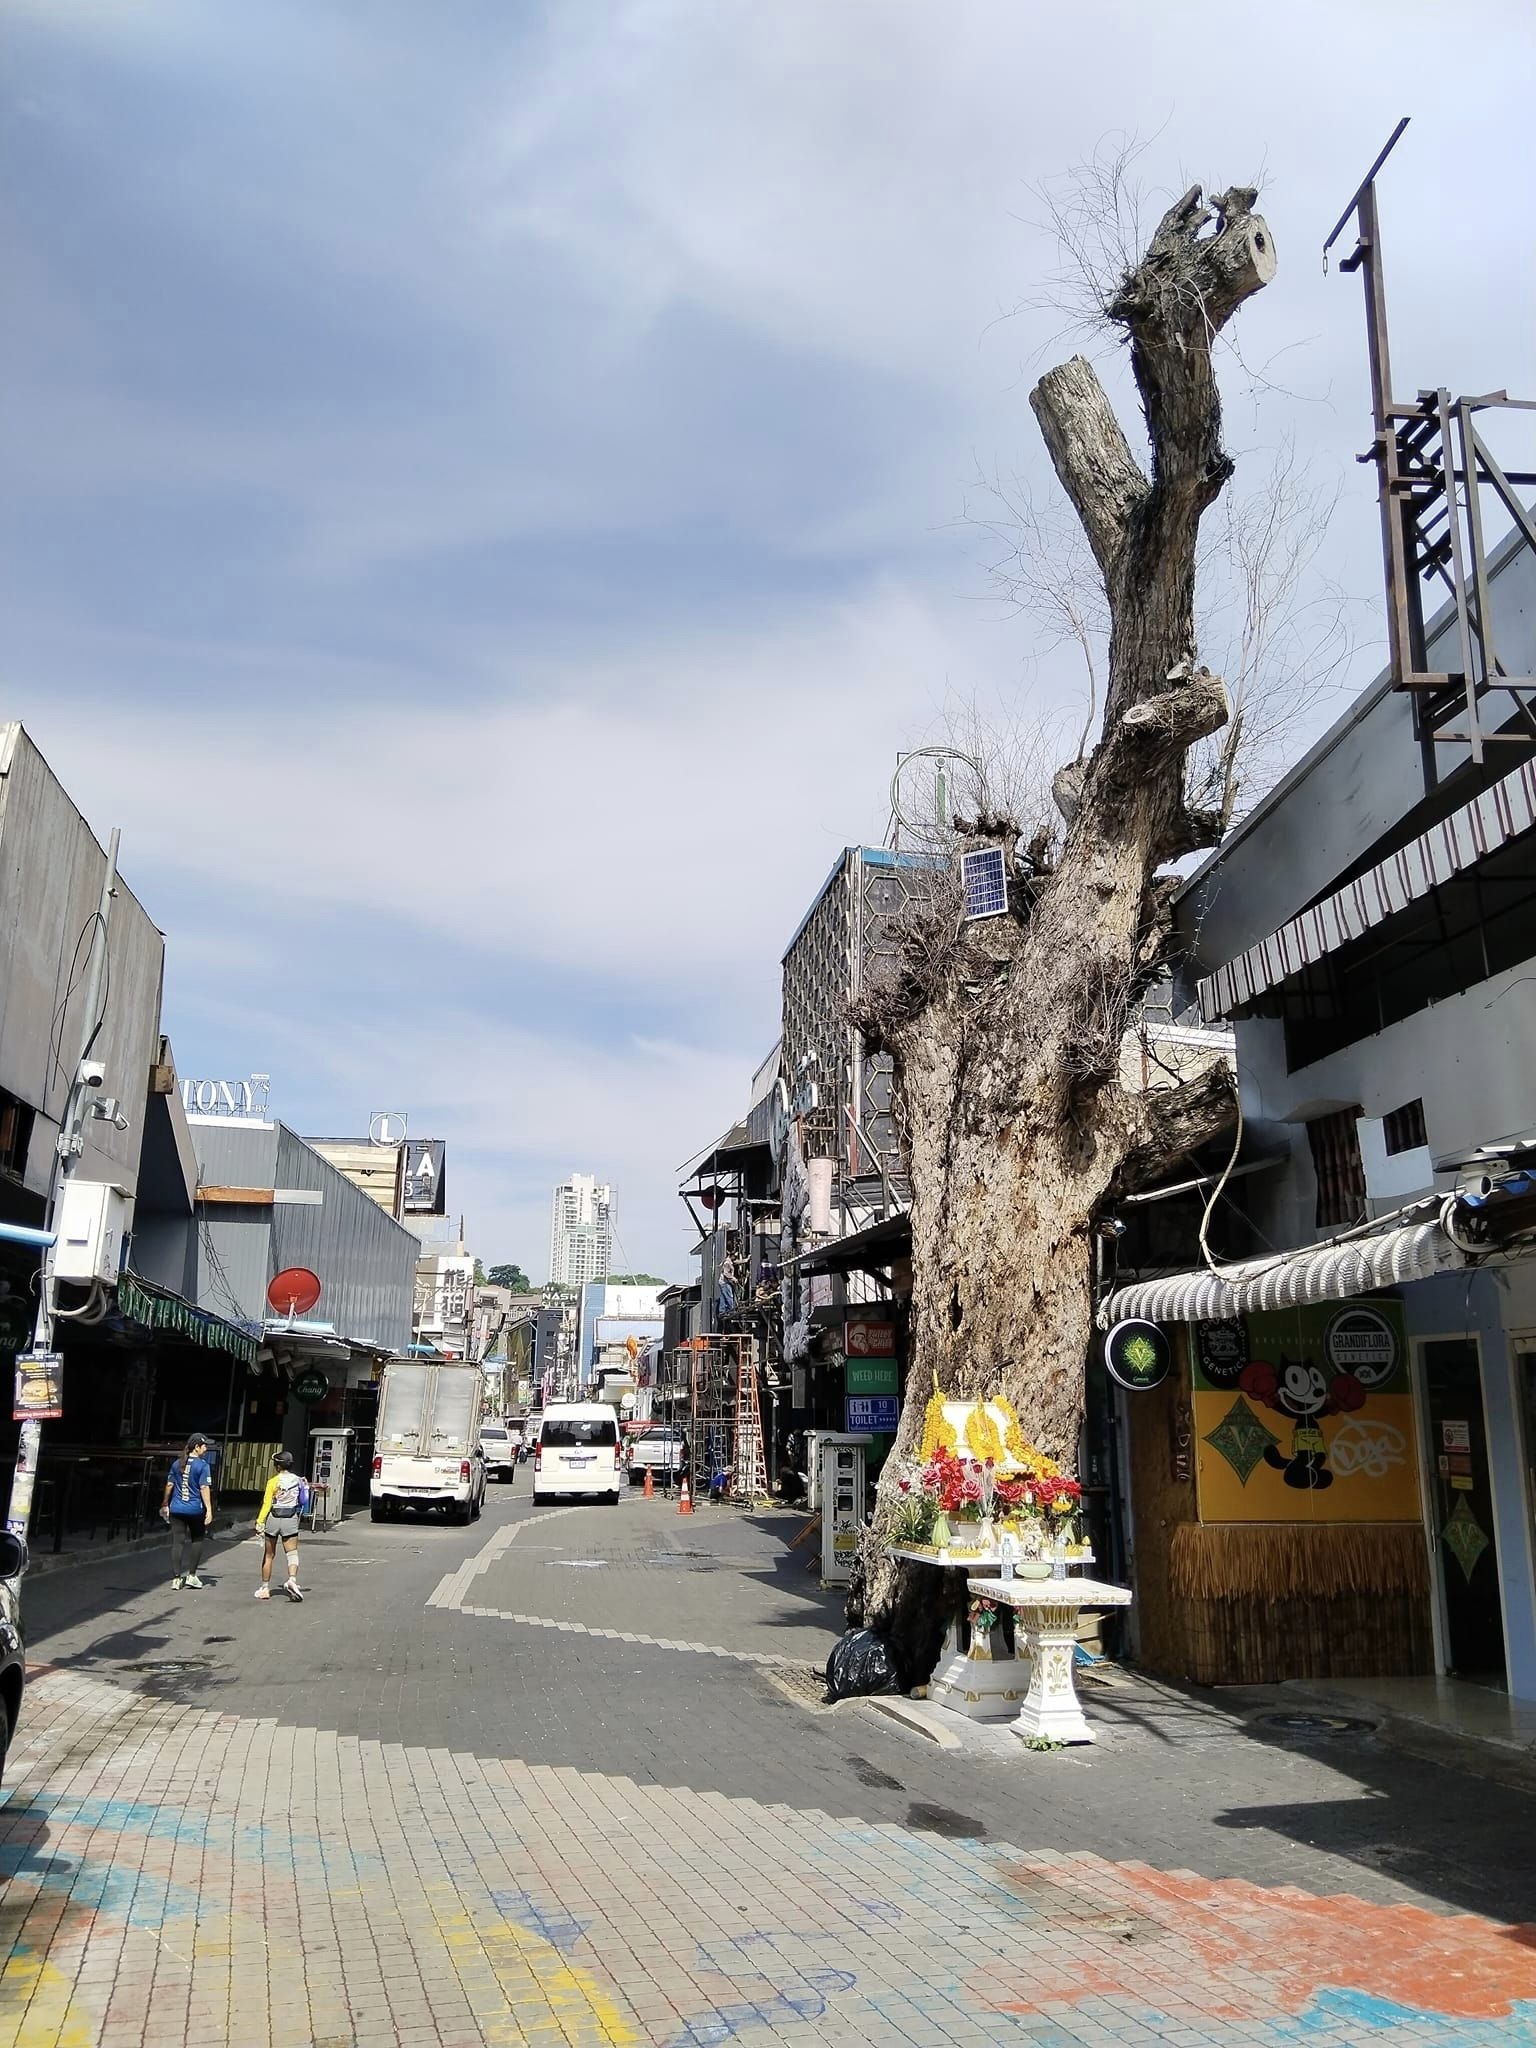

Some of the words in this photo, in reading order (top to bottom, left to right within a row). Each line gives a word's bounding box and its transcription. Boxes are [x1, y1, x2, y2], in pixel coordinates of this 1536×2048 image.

[1332, 1334, 1391, 1348] GRANDIFLORA
[1202, 1356, 1247, 1376] GENETICS
[852, 1369, 873, 1382] WEED
[878, 1400, 888, 1409] 10
[849, 1415, 878, 1425] TOILET
